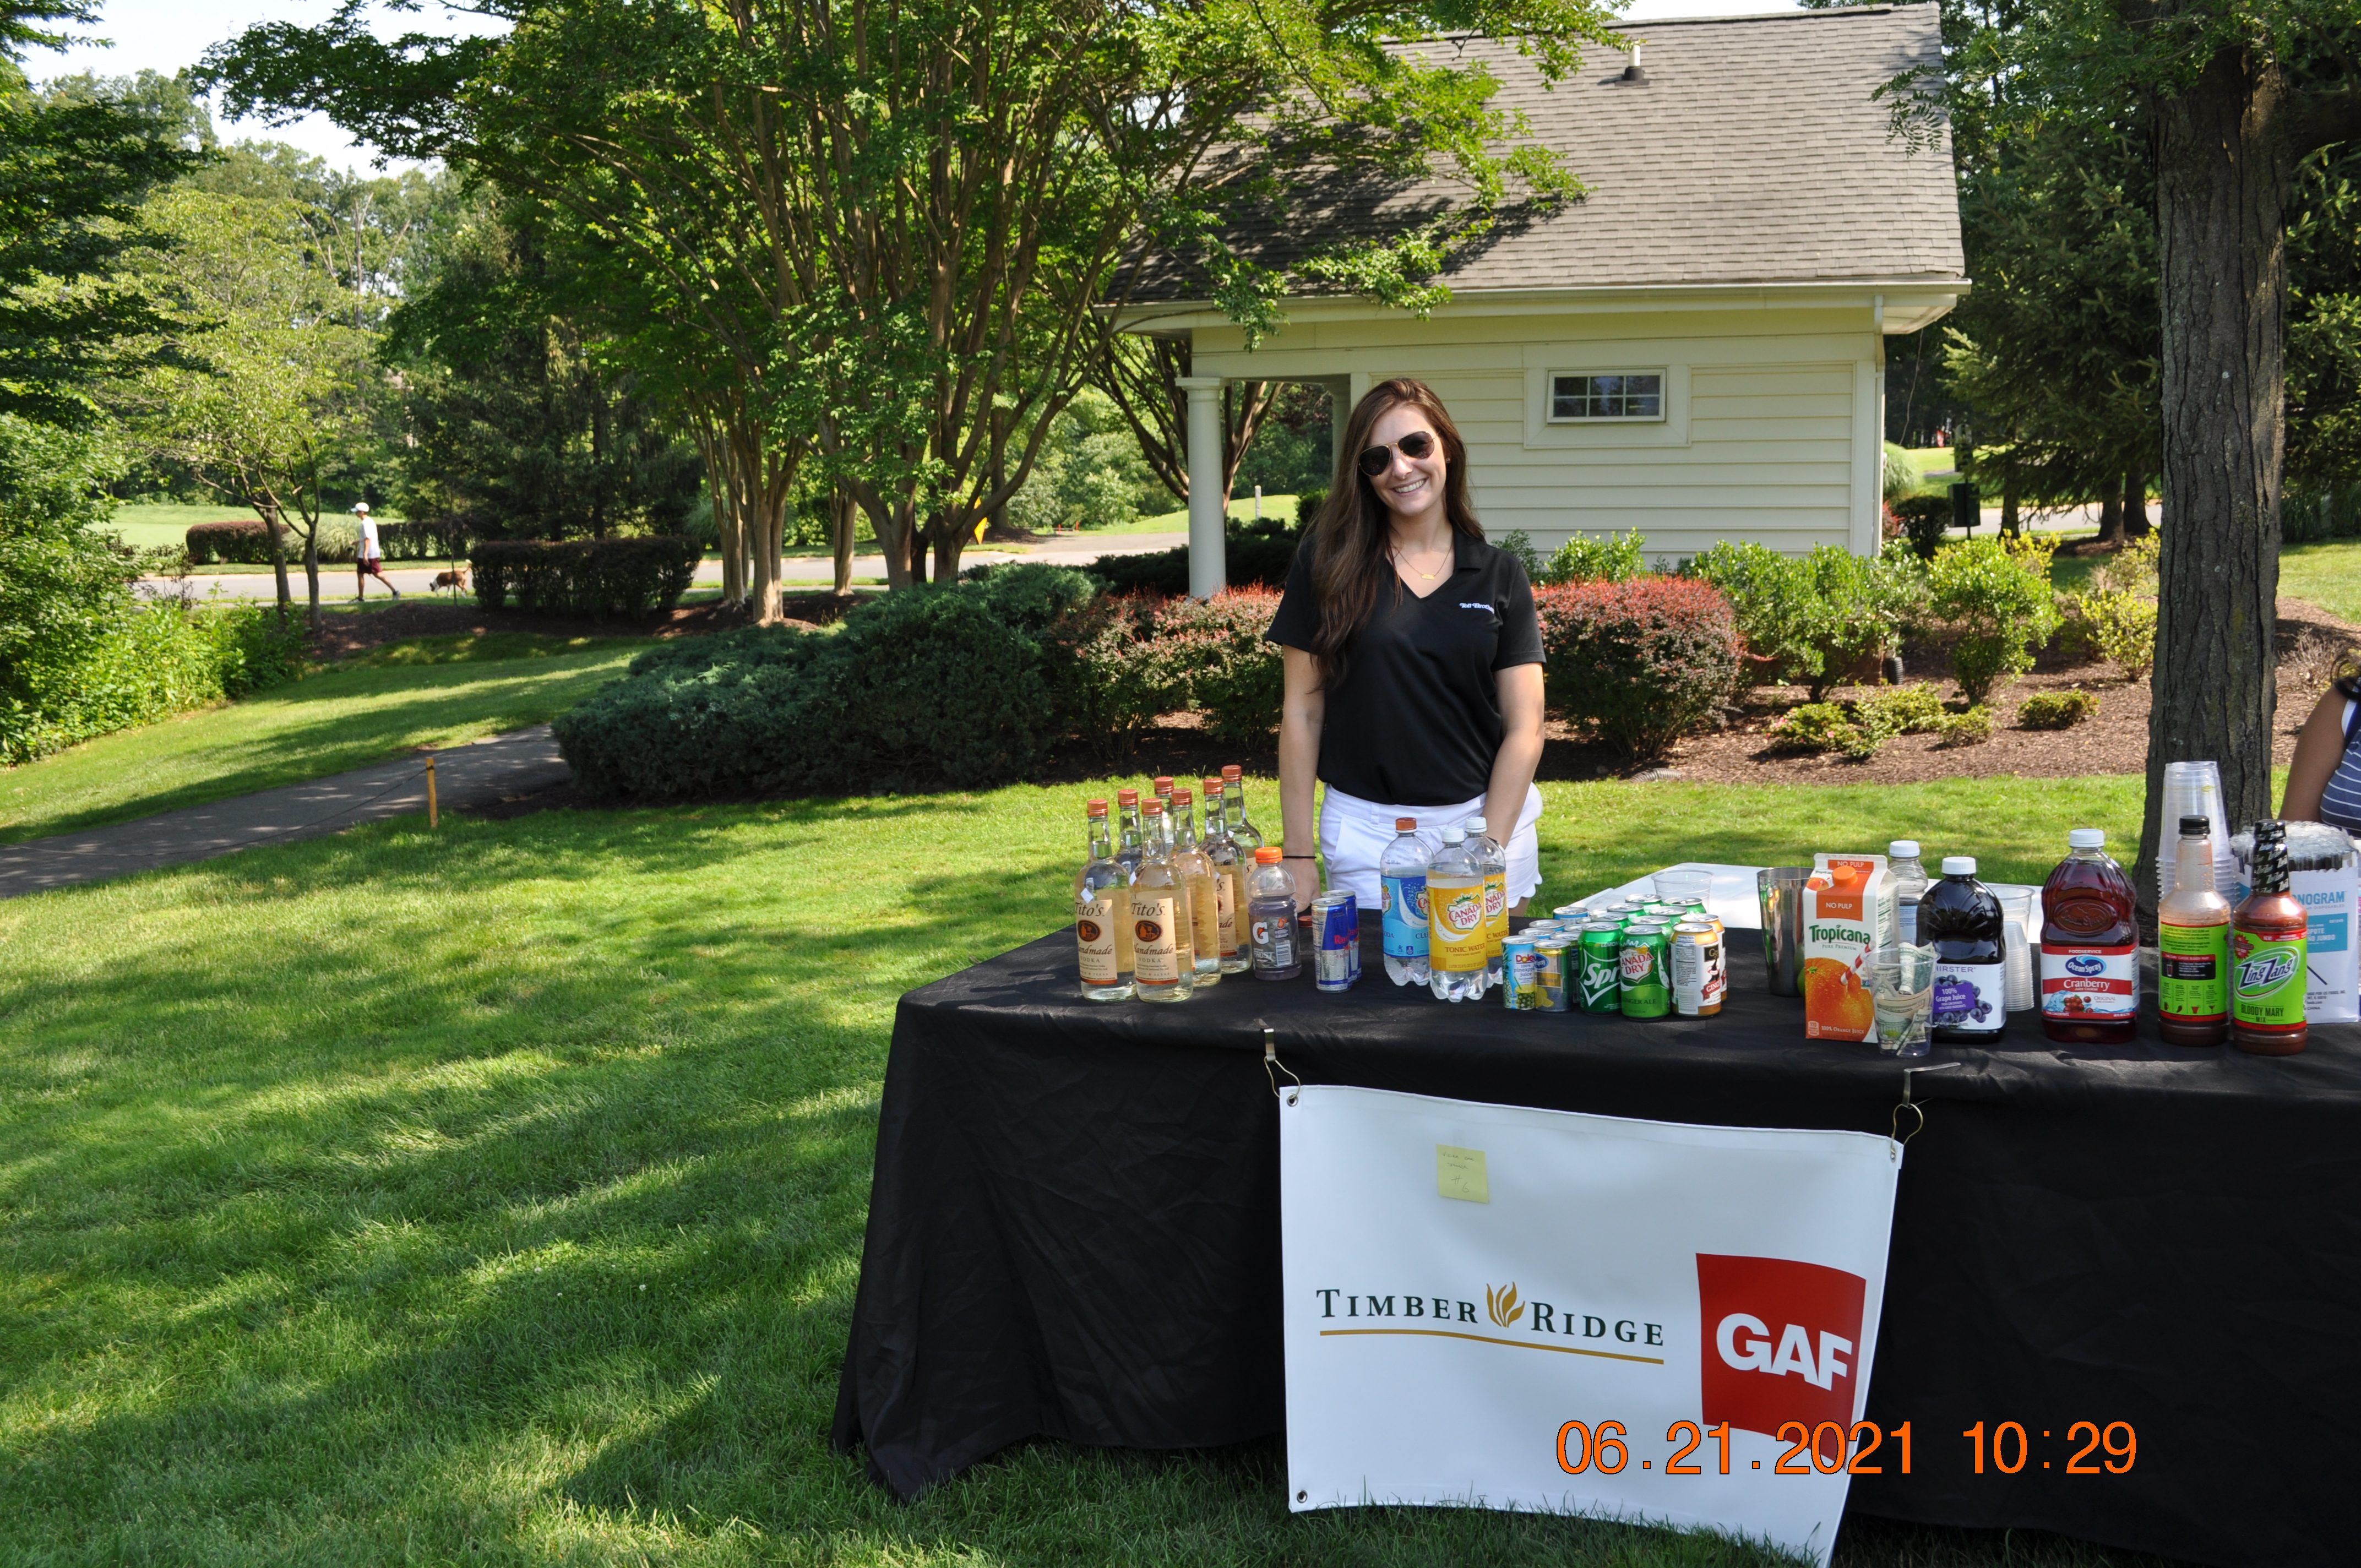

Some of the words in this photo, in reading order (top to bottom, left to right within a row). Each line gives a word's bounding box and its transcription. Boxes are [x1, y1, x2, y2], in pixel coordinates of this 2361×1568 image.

[1486, 890, 1505, 905] NADA
[2292, 891, 2344, 905] NOGRAM
[1075, 902, 1104, 917] Tito's
[1131, 902, 1165, 916] Tito's
[1448, 902, 1482, 922] CANADA
[1486, 900, 1502, 913] DRY
[1461, 912, 1478, 926] DRY
[1252, 922, 1269, 945] G
[1493, 930, 1508, 938] WATER
[1809, 924, 1871, 945] Tropicana
[1078, 944, 1113, 955] andmade
[1468, 943, 1486, 951] WATER
[1516, 954, 1535, 963] Dole
[1620, 952, 1654, 967] ANADA
[1625, 963, 1645, 975] DRY
[2067, 961, 2085, 973] Ocean
[2085, 962, 2102, 974] Spray
[1584, 963, 1620, 989] Spr
[2063, 978, 2110, 992] Cranberry
[2241, 1004, 2263, 1016] BLOODY
[2265, 1006, 2284, 1017] MARY
[1462, 1182, 1470, 1193] 6
[1316, 1289, 1478, 1324] TIMBER
[1531, 1302, 1664, 1346] RIDGE
[1716, 1313, 1853, 1391] GAF
